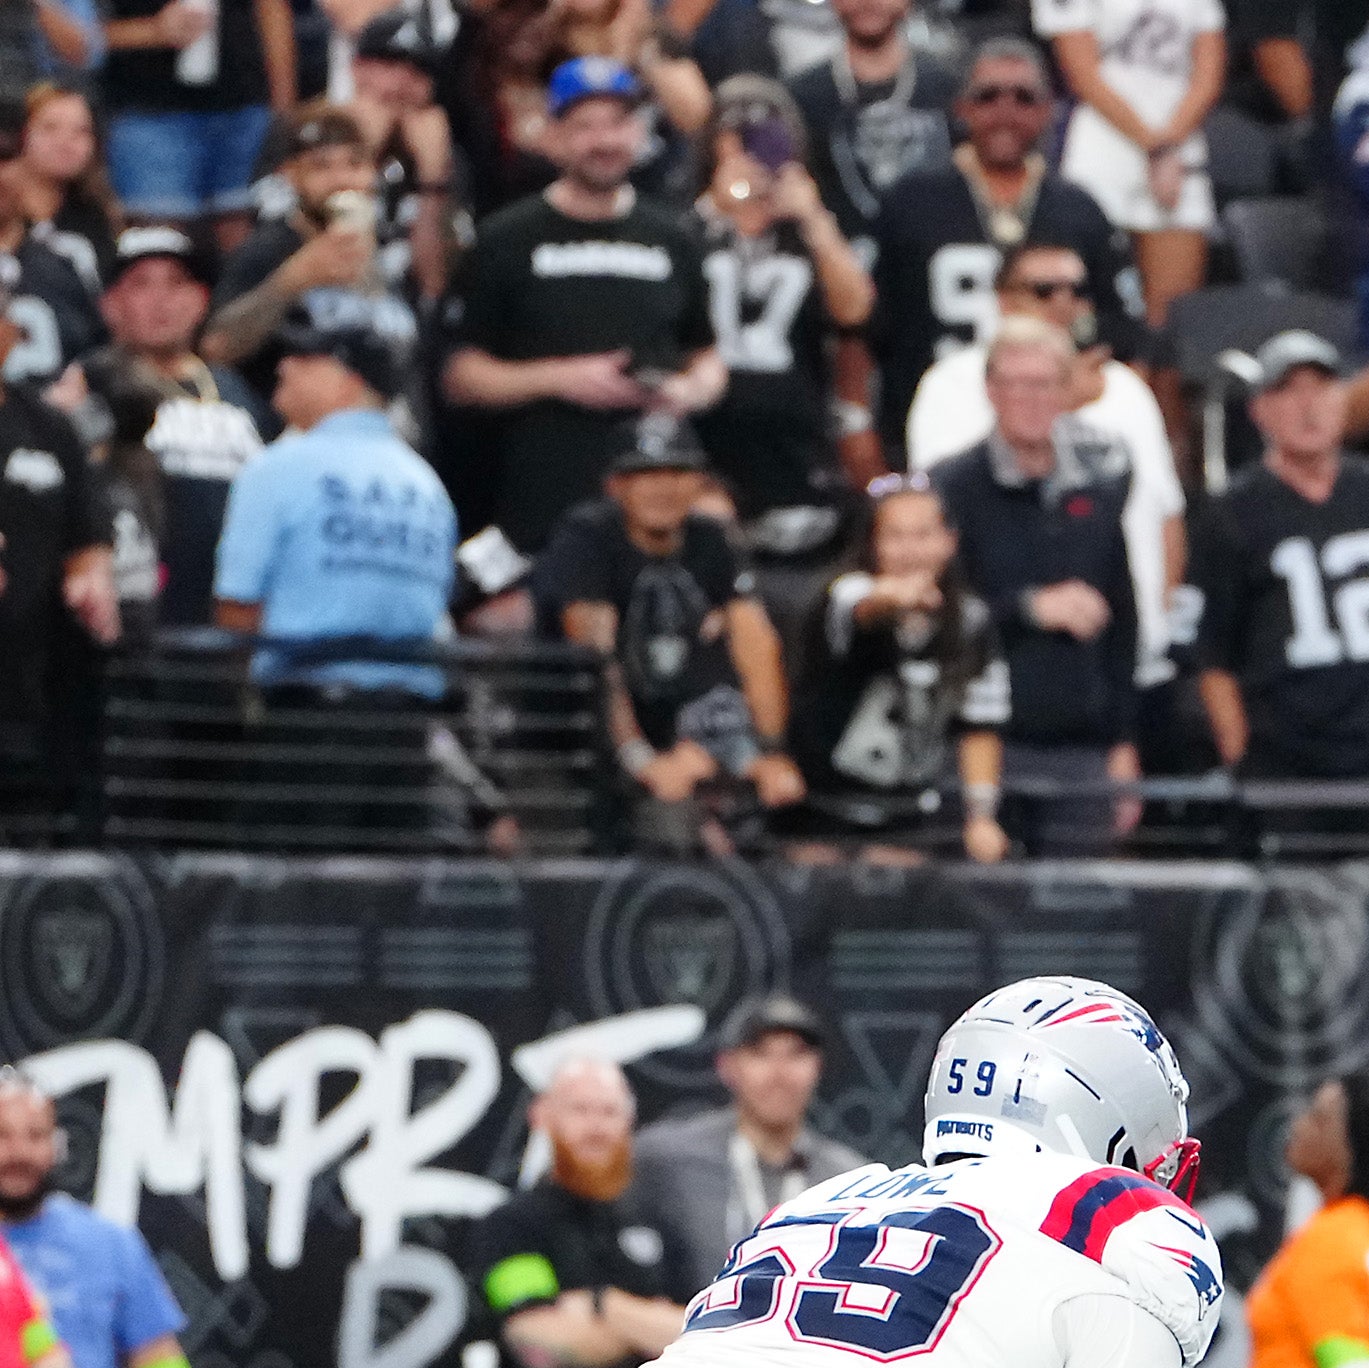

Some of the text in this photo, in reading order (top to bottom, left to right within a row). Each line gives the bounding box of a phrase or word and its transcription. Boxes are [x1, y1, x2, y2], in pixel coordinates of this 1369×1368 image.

[704, 252, 812, 372] 17
[947, 1058, 998, 1097] 59
[683, 1200, 1004, 1364] 59
